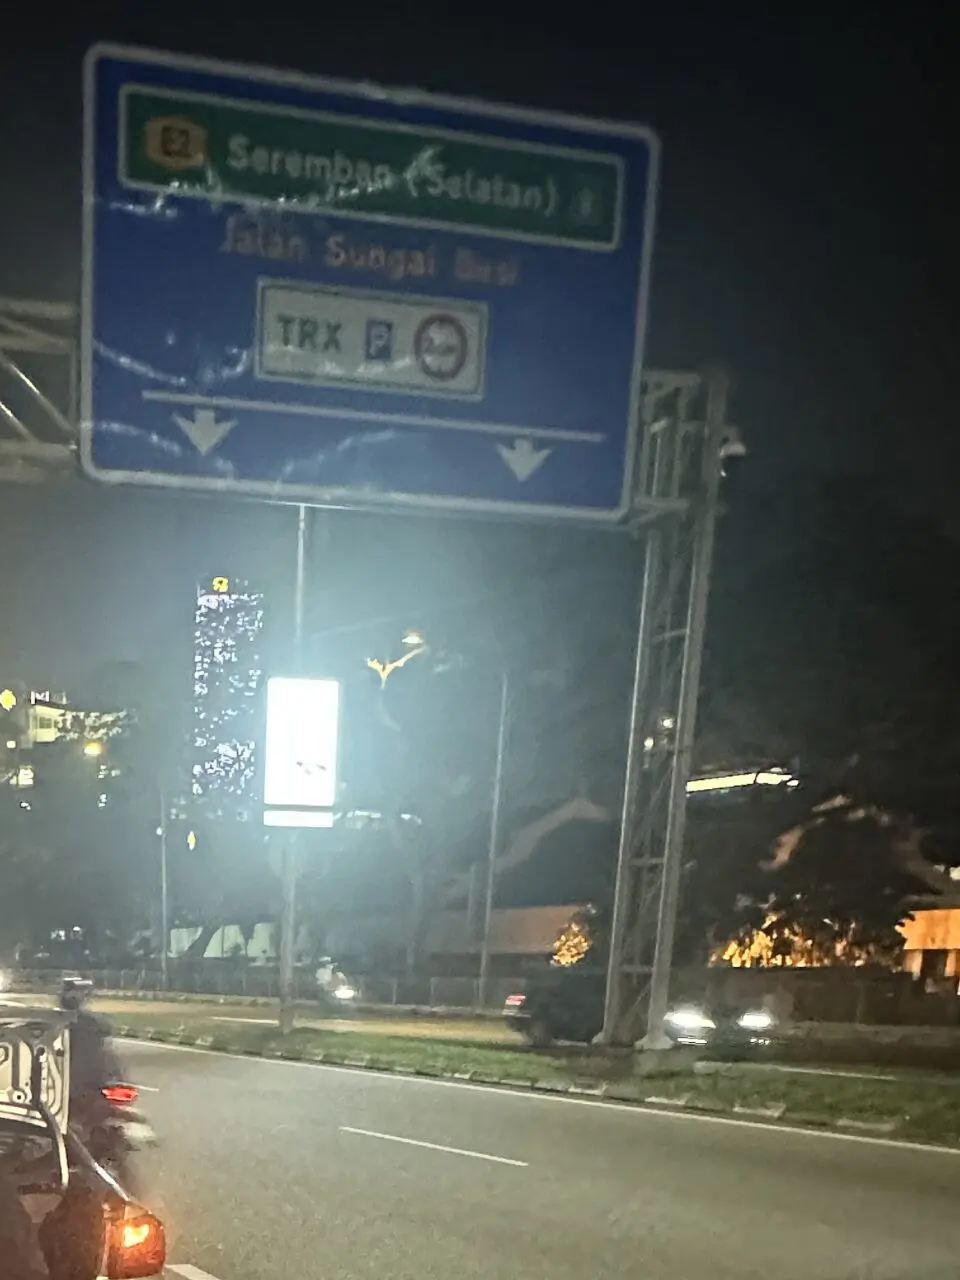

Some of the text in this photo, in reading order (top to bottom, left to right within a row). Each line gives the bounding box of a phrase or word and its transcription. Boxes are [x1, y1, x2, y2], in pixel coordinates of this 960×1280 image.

[226, 135, 392, 186] Seremban
[325, 234, 437, 280] Sungai
[277, 313, 342, 350] TRX
